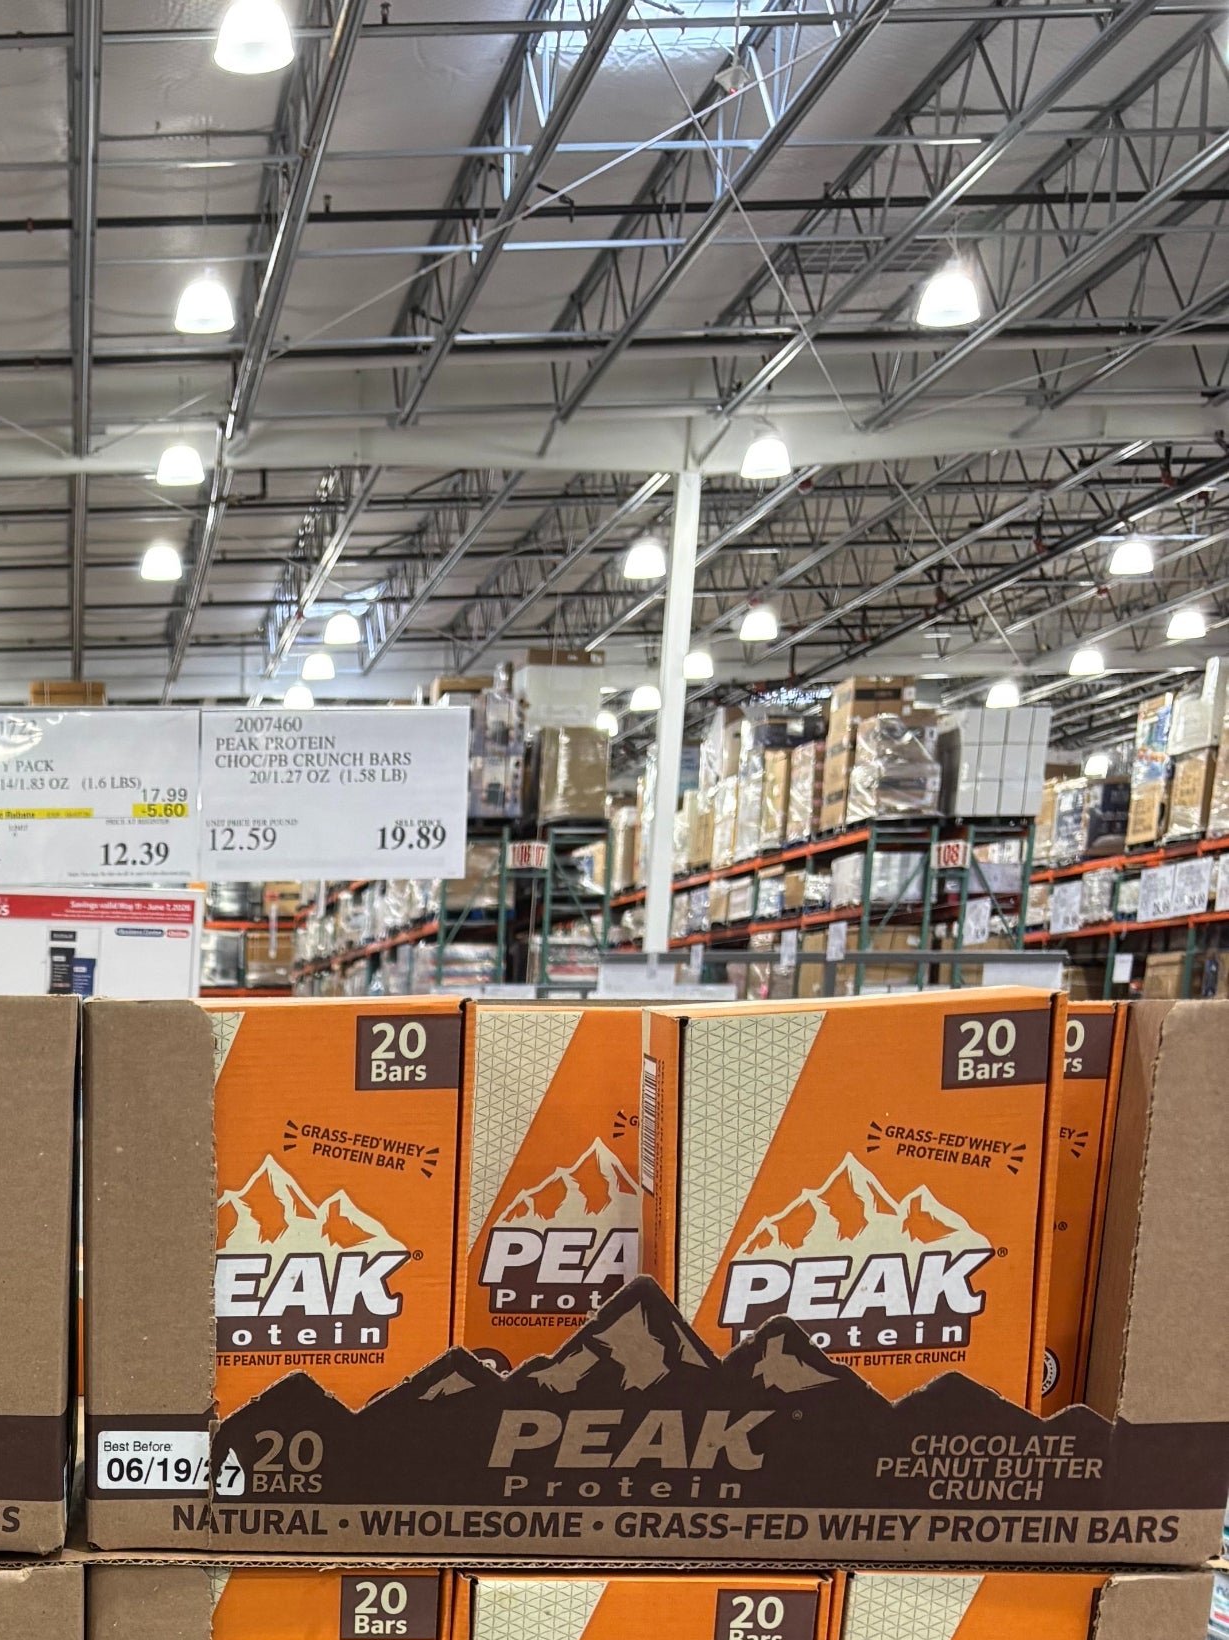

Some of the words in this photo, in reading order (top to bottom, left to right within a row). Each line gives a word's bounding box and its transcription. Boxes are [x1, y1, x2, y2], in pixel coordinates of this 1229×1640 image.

[235, 717, 302, 733] 2007460
[216, 737, 258, 751] PEAK
[265, 736, 335, 749] PROTEIN
[15, 760, 55, 772] PACK
[215, 754, 288, 768] CHOC/PB
[293, 753, 364, 767] CRUNCH
[370, 752, 412, 766] BARS
[0, 778, 46, 791] 14/1.83
[49, 778, 69, 790] OZ
[82, 777, 107, 790] (1.6
[111, 777, 142, 790] LBS)
[250, 771, 302, 784] 20/1.27
[307, 770, 330, 783] OZ
[339, 769, 376, 785] (1.58
[381, 769, 407, 783] LB)
[141, 788, 188, 802] 17.99
[140, 803, 185, 817] -5.60
[209, 828, 277, 851] 12.59
[377, 827, 446, 850] 19.89
[100, 842, 169, 866] 12.39
[104, 1441, 131, 1453] Best
[133, 1441, 173, 1453] Before:
[488, 1409, 773, 1470] PEAK
[911, 1435, 1076, 1457] CHOCOLATE
[876, 1457, 991, 1478] PEANUT
[994, 1458, 1103, 1479] BUTTER
[503, 1475, 741, 1499] Protein
[928, 1480, 1044, 1501] CRUNCH
[173, 1504, 328, 1537] NATURAL
[360, 1510, 583, 1539] WHOLESOME
[614, 1511, 809, 1541] GRASS-FED
[818, 1515, 922, 1542] WHEY
[927, 1515, 1079, 1544] PROTEIN
[1087, 1516, 1180, 1544] BARS
